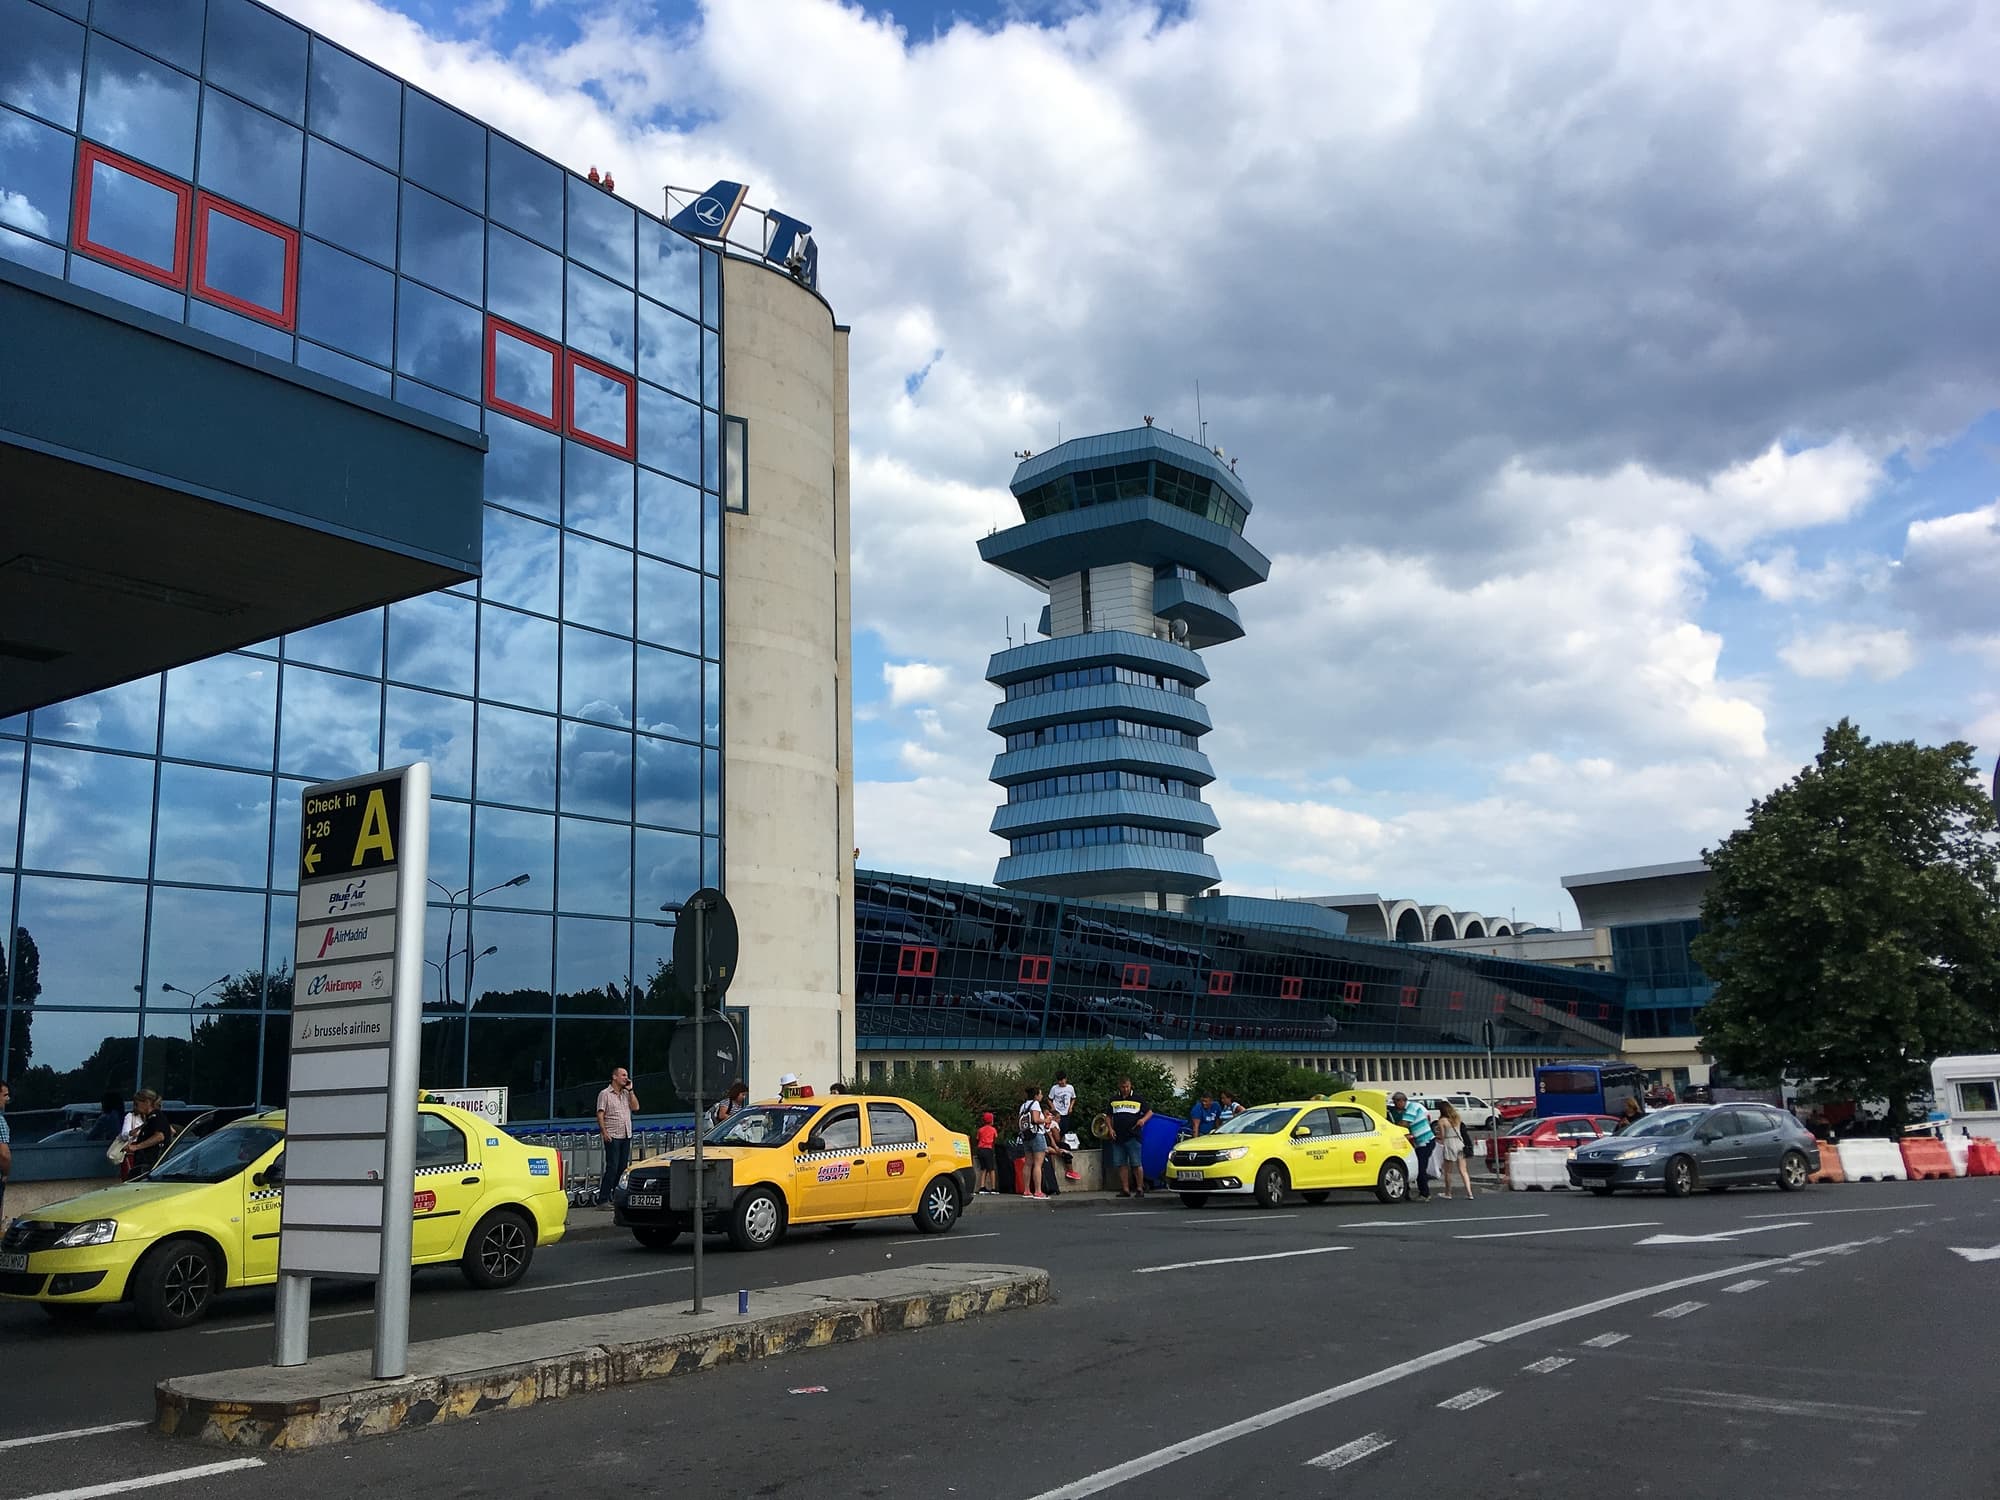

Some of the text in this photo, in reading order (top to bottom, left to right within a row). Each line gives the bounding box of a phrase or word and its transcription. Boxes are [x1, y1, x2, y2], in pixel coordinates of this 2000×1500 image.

[307, 792, 356, 815] Check in
[306, 820, 331, 839] 1-26
[352, 788, 395, 867] A
[329, 892, 350, 903] Blue
[314, 1020, 381, 1038] brussels airlines
